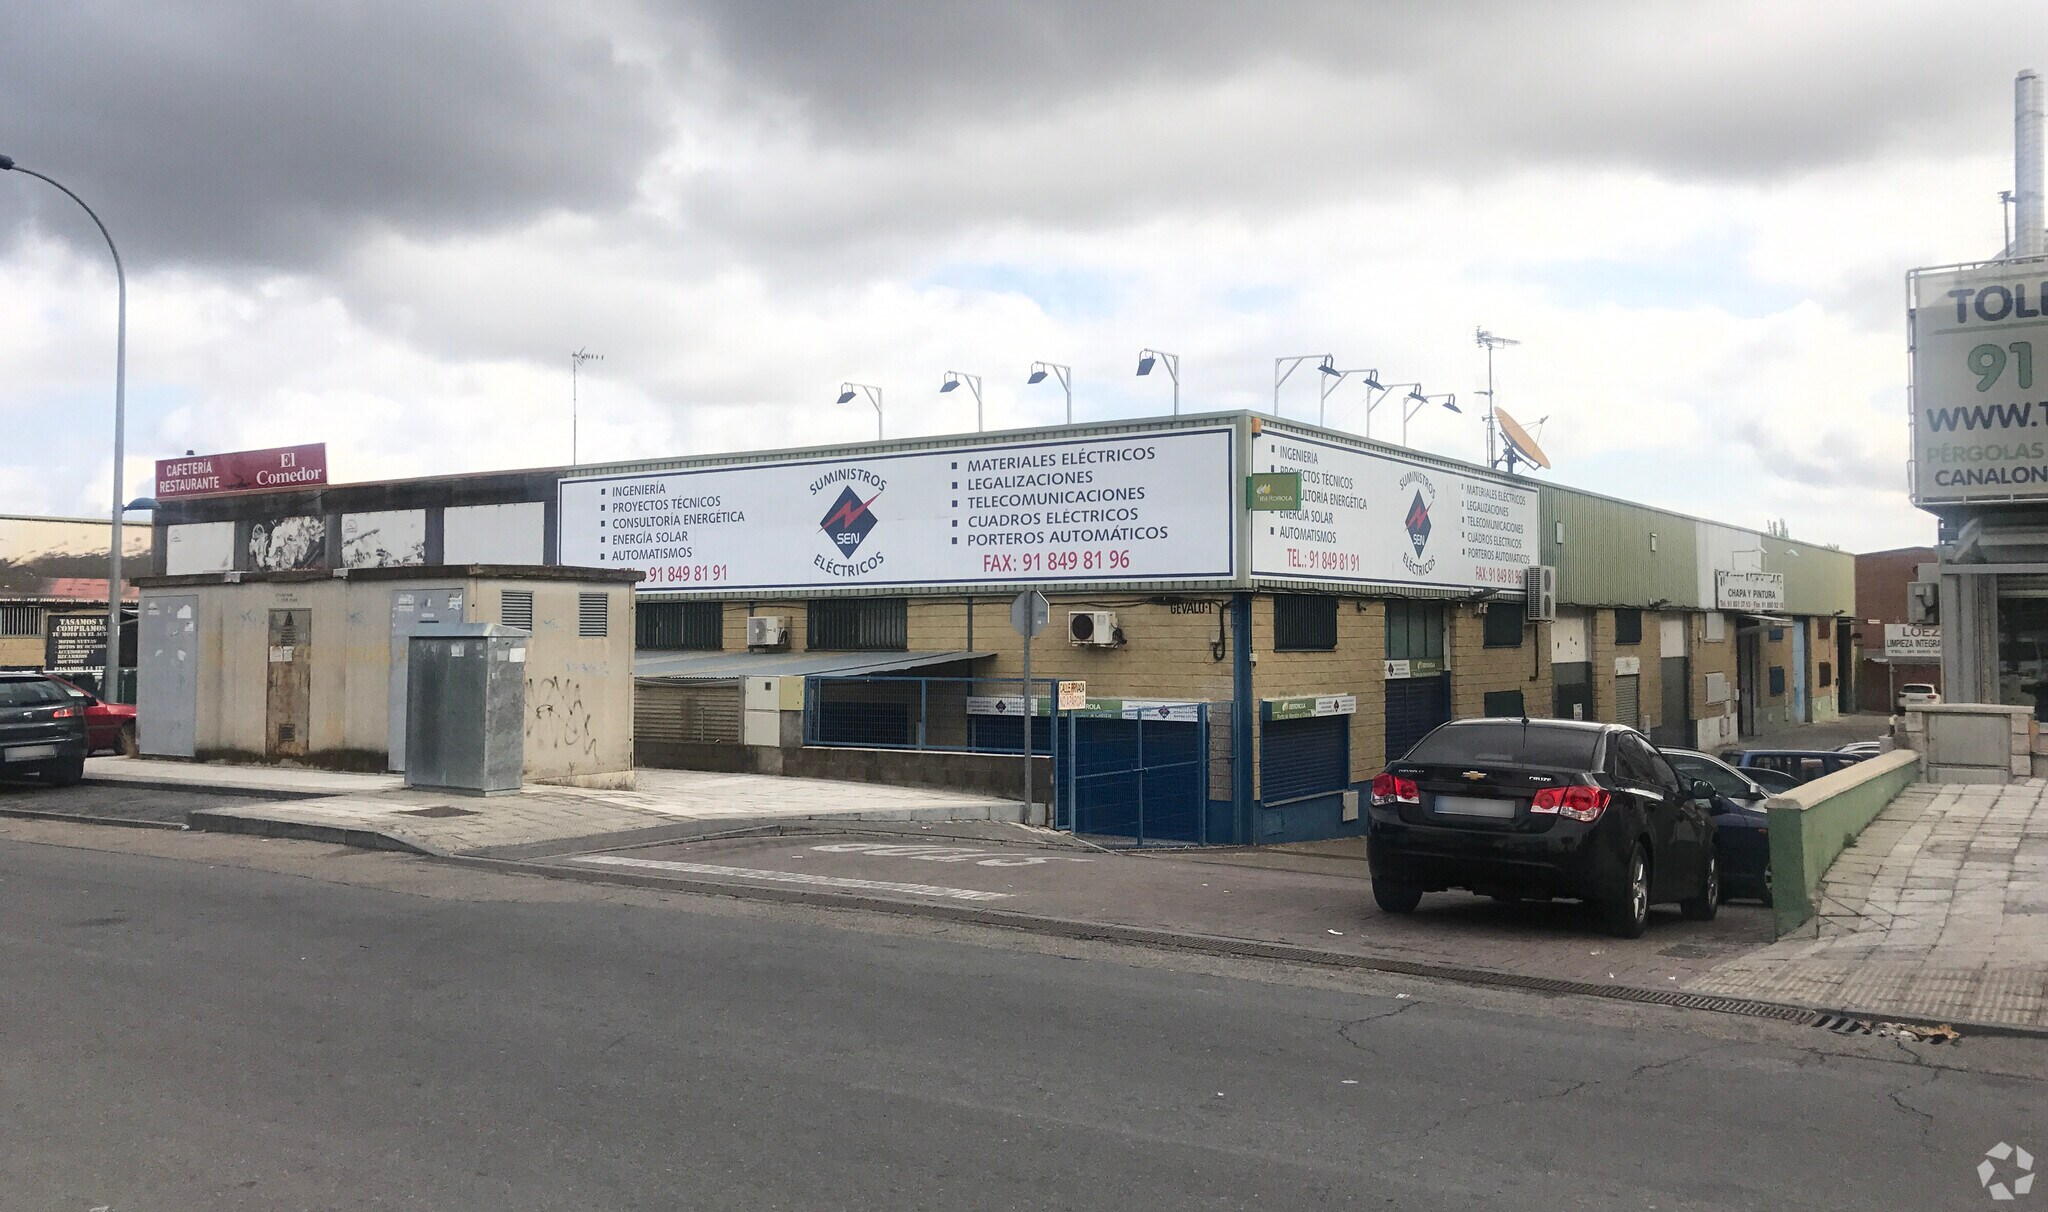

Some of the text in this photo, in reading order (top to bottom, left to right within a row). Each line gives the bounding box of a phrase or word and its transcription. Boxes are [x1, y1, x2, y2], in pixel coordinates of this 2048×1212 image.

[1947, 281, 2048, 323] TOL
[1967, 341, 2033, 393] 91
[280, 452, 296, 468] El
[968, 446, 1156, 472] MATERIALES ELÉCTRICOS
[1280, 446, 1318, 464] INGENIERÍA
[1926, 442, 2044, 464] PÉRGOLAS
[166, 459, 212, 477] CAFETERÍA
[256, 466, 322, 486] Comedor
[160, 476, 219, 493] RESTAURANTE
[810, 468, 887, 495] SUMINISTROS
[968, 470, 1093, 491] LEGALIZACIONES
[1322, 470, 1353, 489] TÉCNICOS
[1400, 471, 1436, 499] SUMINISTROS
[612, 481, 666, 497] INGENIERÍA
[968, 486, 1145, 509] TELECOMUNICACIONES
[1466, 484, 1497, 500] MATERIALES
[612, 495, 721, 513] PROYECTOS TÉCNICOS
[1330, 493, 1368, 510] ENERGÉTICA
[1467, 500, 1509, 517] LEGALIZACIONES
[612, 509, 745, 529] CONSULTORÍA ENERGÉTICA
[968, 507, 1139, 528] CUADROS ELÉCTRICOS
[1280, 506, 1333, 524] ENERGÍA SOLAR
[1467, 516, 1523, 534] TELECOMUNICACIONES
[612, 530, 688, 545] ENERGÍA SOLAR
[837, 533, 860, 544] SEN
[968, 525, 1168, 546] PORTEROS AUTOMÁTICOS
[1280, 526, 1336, 544] AUTOMATISMOS
[1413, 534, 1425, 545] SEN
[1468, 532, 1492, 545] CUADROS
[612, 547, 692, 561] AUTOMATISMOS
[983, 549, 1130, 572] FAX: 91 849 81 96
[1310, 550, 1319, 569] 91
[1322, 552, 1337, 570] 849
[1340, 553, 1348, 571] 81
[1351, 554, 1360, 571] 91
[1468, 548, 1494, 560] PORTEROS
[650, 566, 663, 582] 91
[668, 566, 690, 581] 849
[694, 565, 707, 581] 81
[713, 564, 727, 580] 91
[814, 552, 884, 577] ELÉCTRICOS
[1403, 552, 1436, 576] ELÉCTRICOS
[1489, 567, 1496, 582] 91
[1496, 568, 1507, 583] 849
[1508, 569, 1515, 583] 81
[1515, 570, 1522, 584] 96
[1728, 589, 1776, 599] CHAPA Y PINTURA
[1887, 639, 1913, 648] LIMPIEZA
